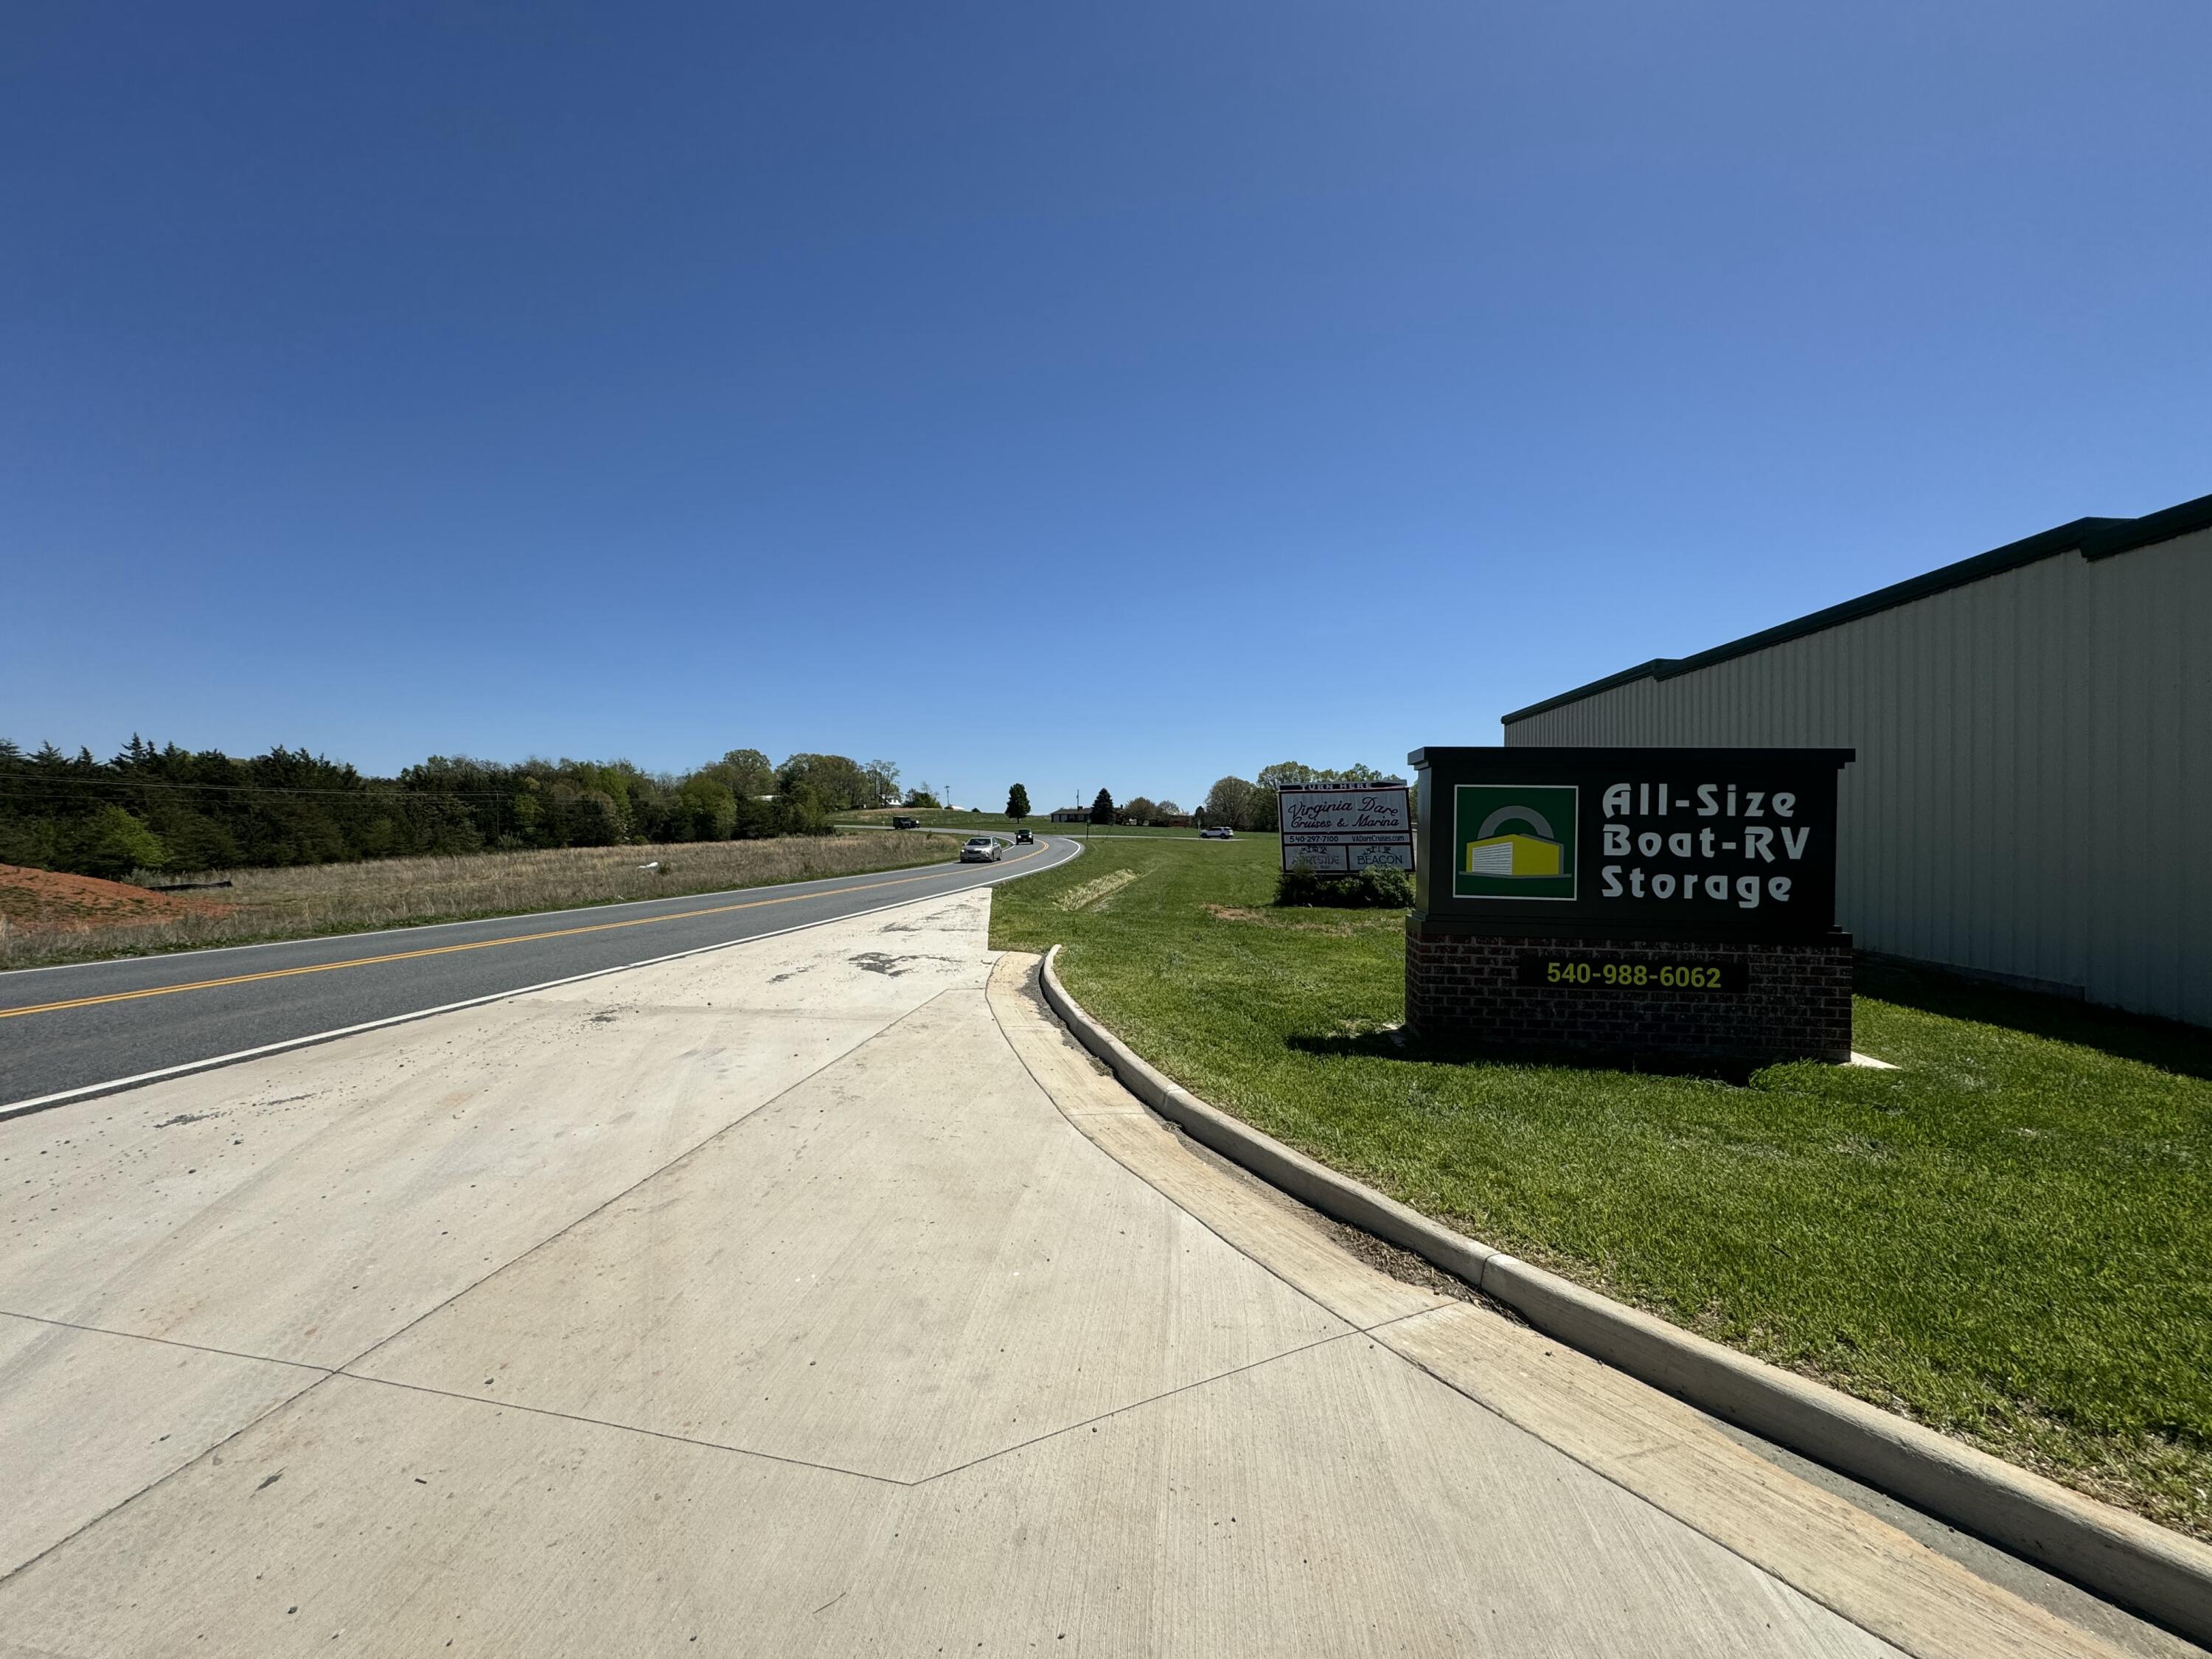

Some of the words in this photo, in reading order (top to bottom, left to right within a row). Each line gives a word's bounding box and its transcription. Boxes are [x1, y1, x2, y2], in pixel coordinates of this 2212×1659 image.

[1288, 801, 1353, 820] Virginia
[1357, 796, 1399, 816] Dare
[1601, 782, 1796, 818] All-Size
[1291, 816, 1333, 829] Cruises
[1337, 818, 1349, 827] &
[1352, 813, 1400, 827] Marina
[1602, 824, 1811, 863] Boat-RV
[1357, 855, 1403, 865] BEACON
[1601, 865, 1792, 909] Storage
[1547, 961, 1722, 989] 540-988-6062
